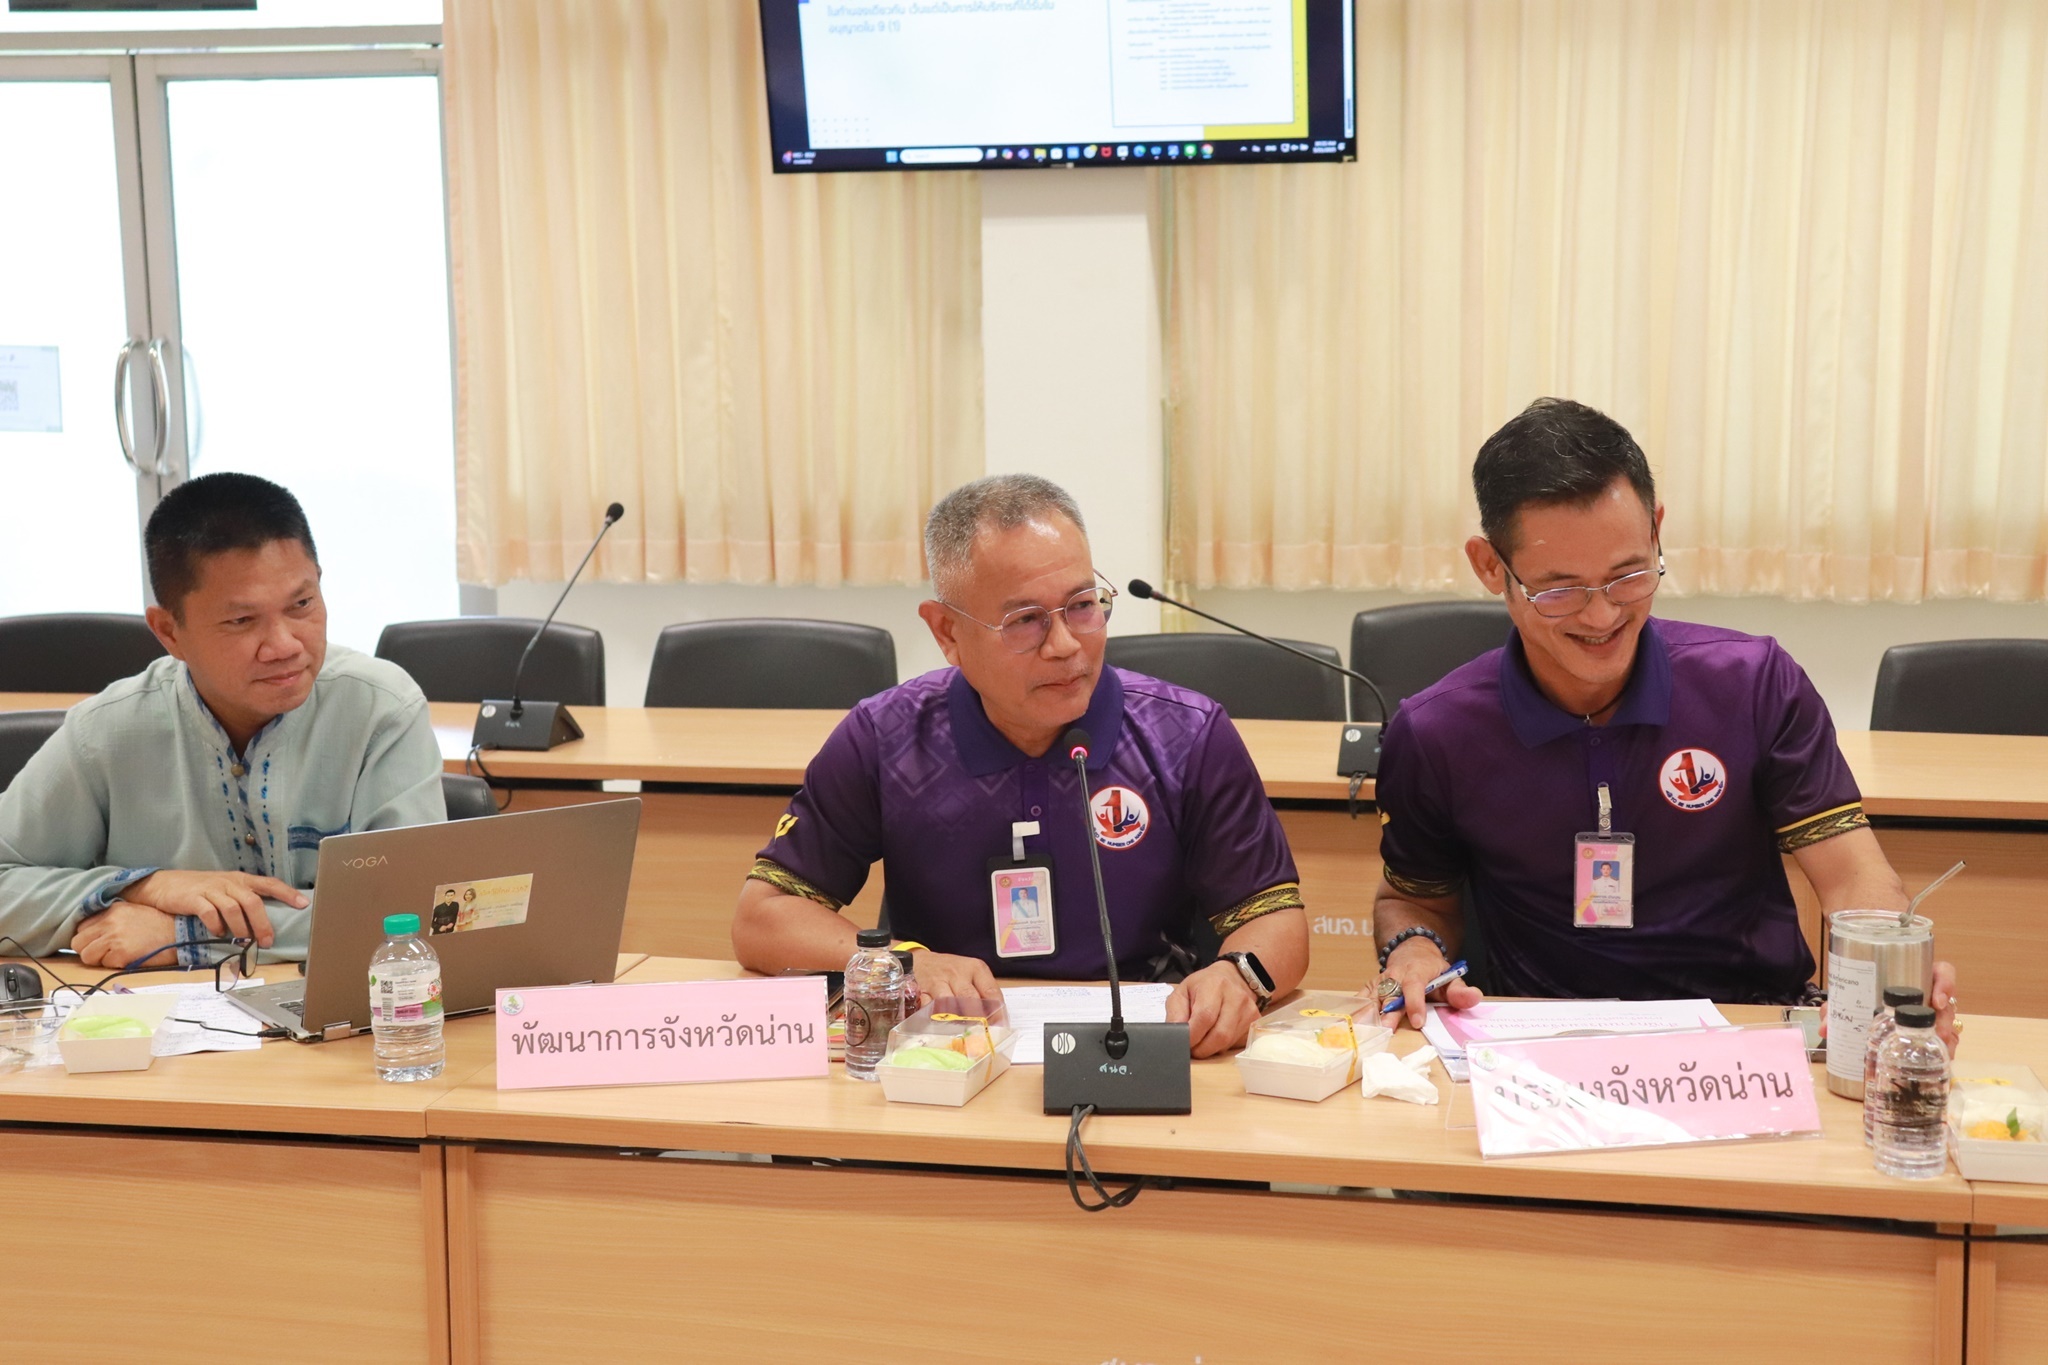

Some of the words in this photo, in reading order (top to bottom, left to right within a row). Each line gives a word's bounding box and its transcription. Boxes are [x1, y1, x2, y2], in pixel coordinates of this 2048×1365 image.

[342, 855, 388, 869] YOGA
[511, 1013, 815, 1055] พัฒนาการจังหวัดน่าน
